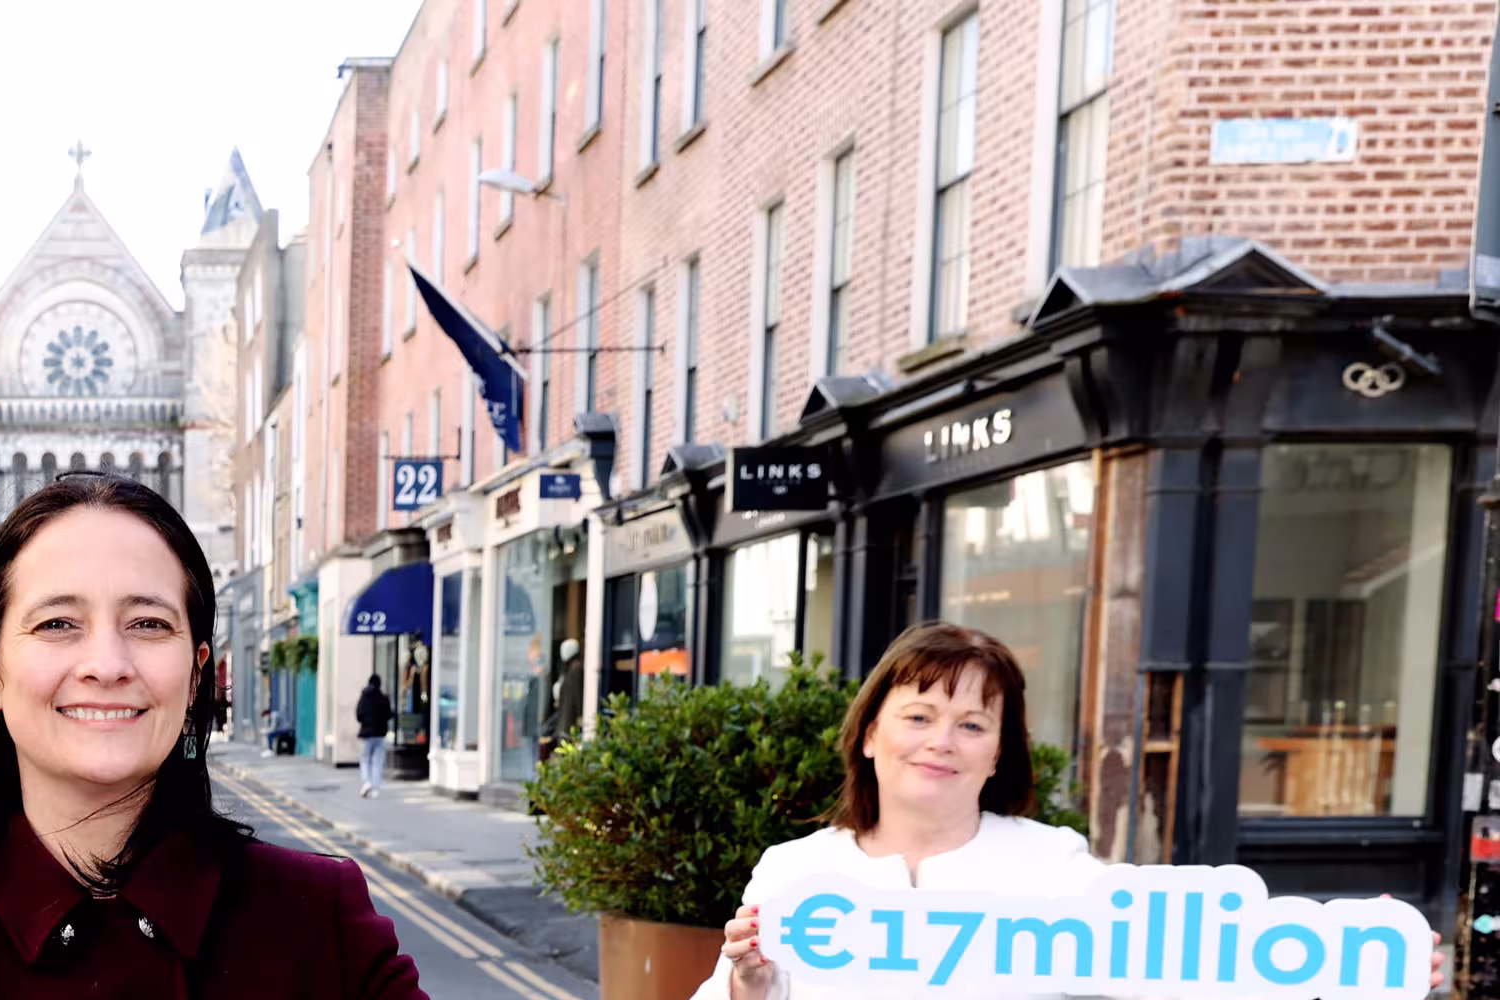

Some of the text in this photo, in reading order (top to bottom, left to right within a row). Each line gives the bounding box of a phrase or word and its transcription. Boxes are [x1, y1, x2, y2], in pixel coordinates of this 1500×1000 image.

[923, 408, 1012, 463] LINKS
[395, 464, 439, 505] 22
[740, 463, 822, 480] LINKS
[356, 610, 387, 632] 22
